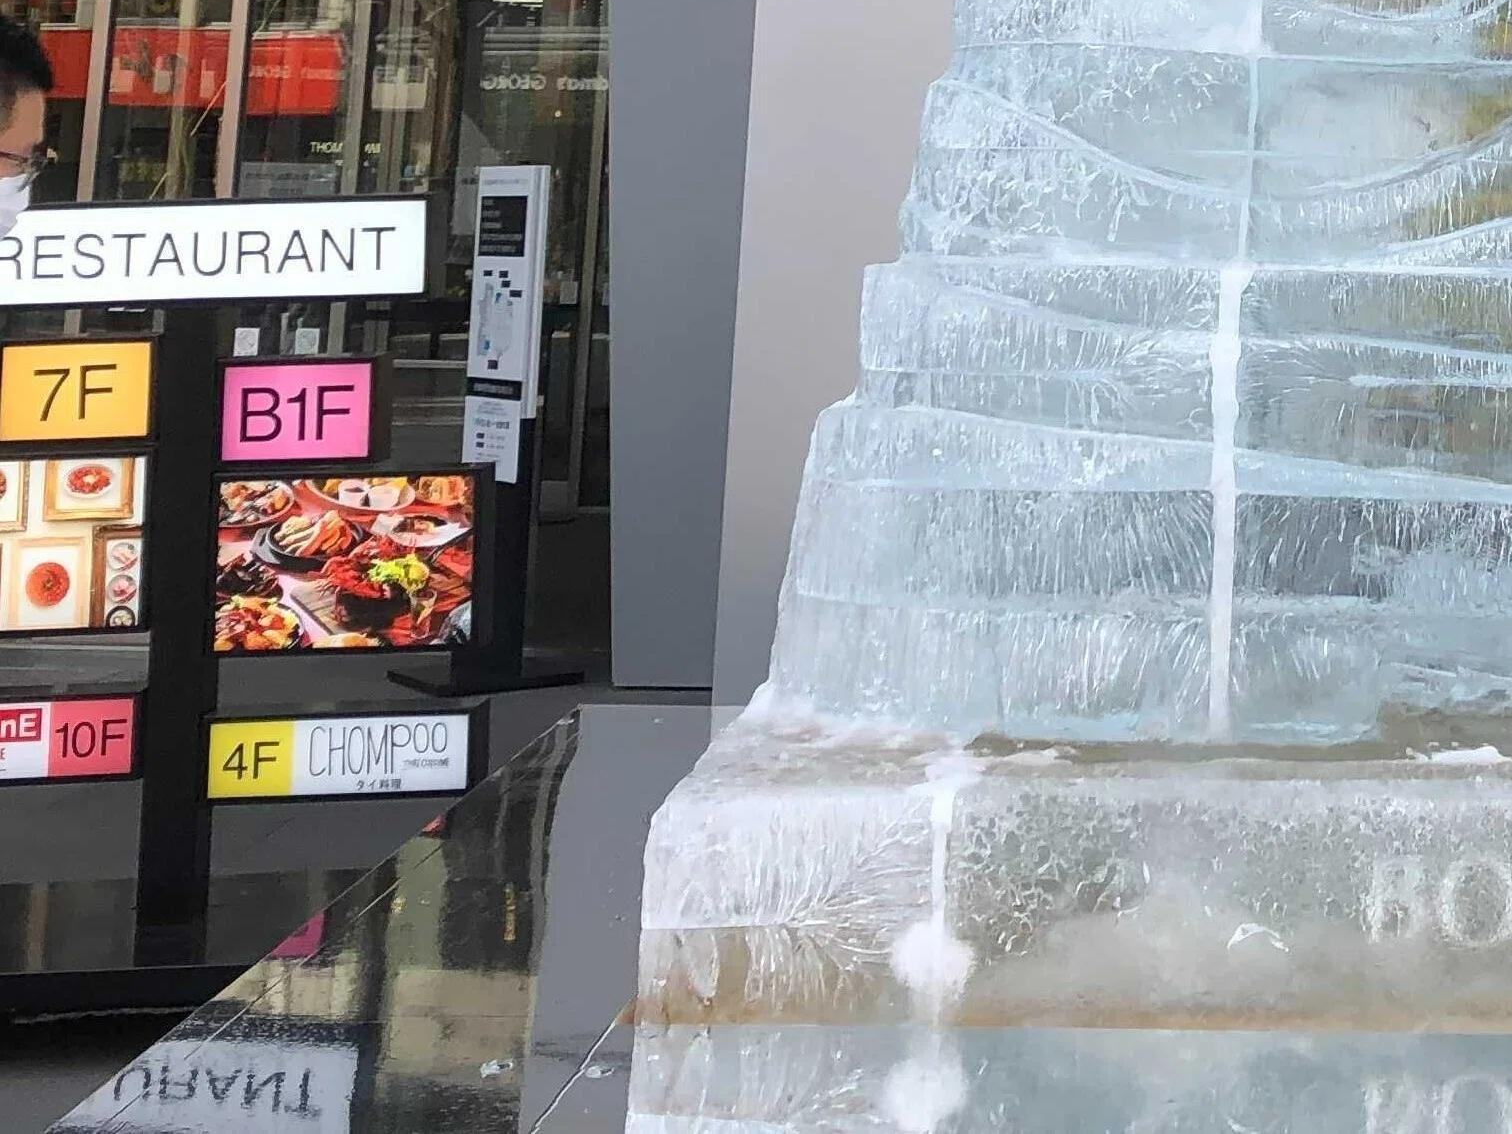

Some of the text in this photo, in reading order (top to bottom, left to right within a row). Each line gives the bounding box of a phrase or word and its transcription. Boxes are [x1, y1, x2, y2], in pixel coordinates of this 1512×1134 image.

[0, 227, 397, 280] RESTAURANT
[33, 363, 118, 422] 7F
[239, 384, 356, 443] B1F
[55, 718, 128, 758] 10F
[222, 741, 280, 780] 4F
[309, 722, 448, 777] CHOMPOO
